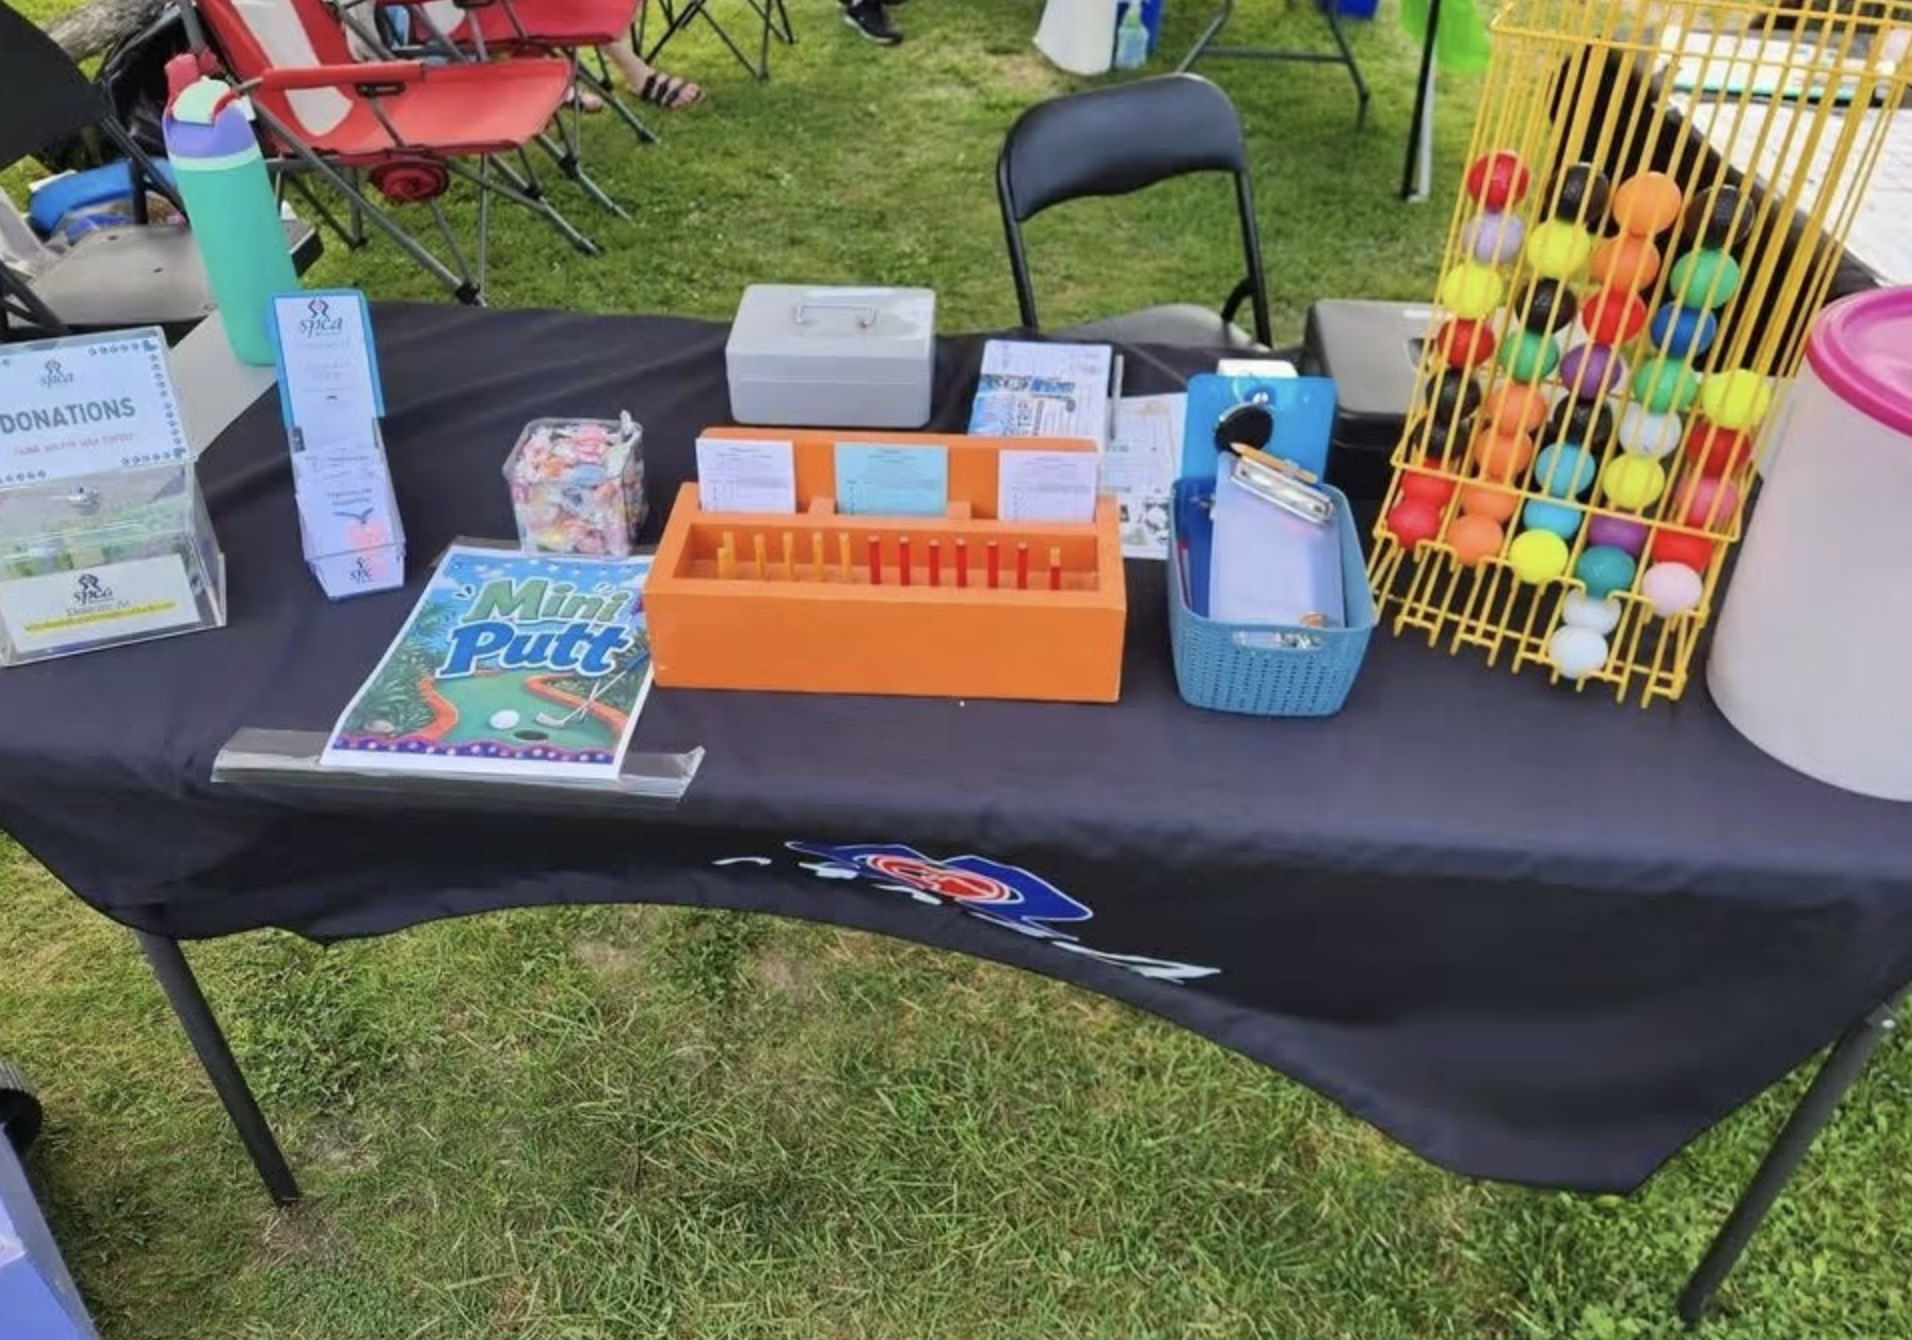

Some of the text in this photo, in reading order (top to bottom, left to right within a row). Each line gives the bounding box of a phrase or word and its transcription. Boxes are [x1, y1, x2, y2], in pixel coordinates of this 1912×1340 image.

[298, 316, 344, 338] spca
[0, 397, 136, 434] DONATIONS
[460, 577, 633, 623] Mini
[437, 621, 634, 678] Putt
